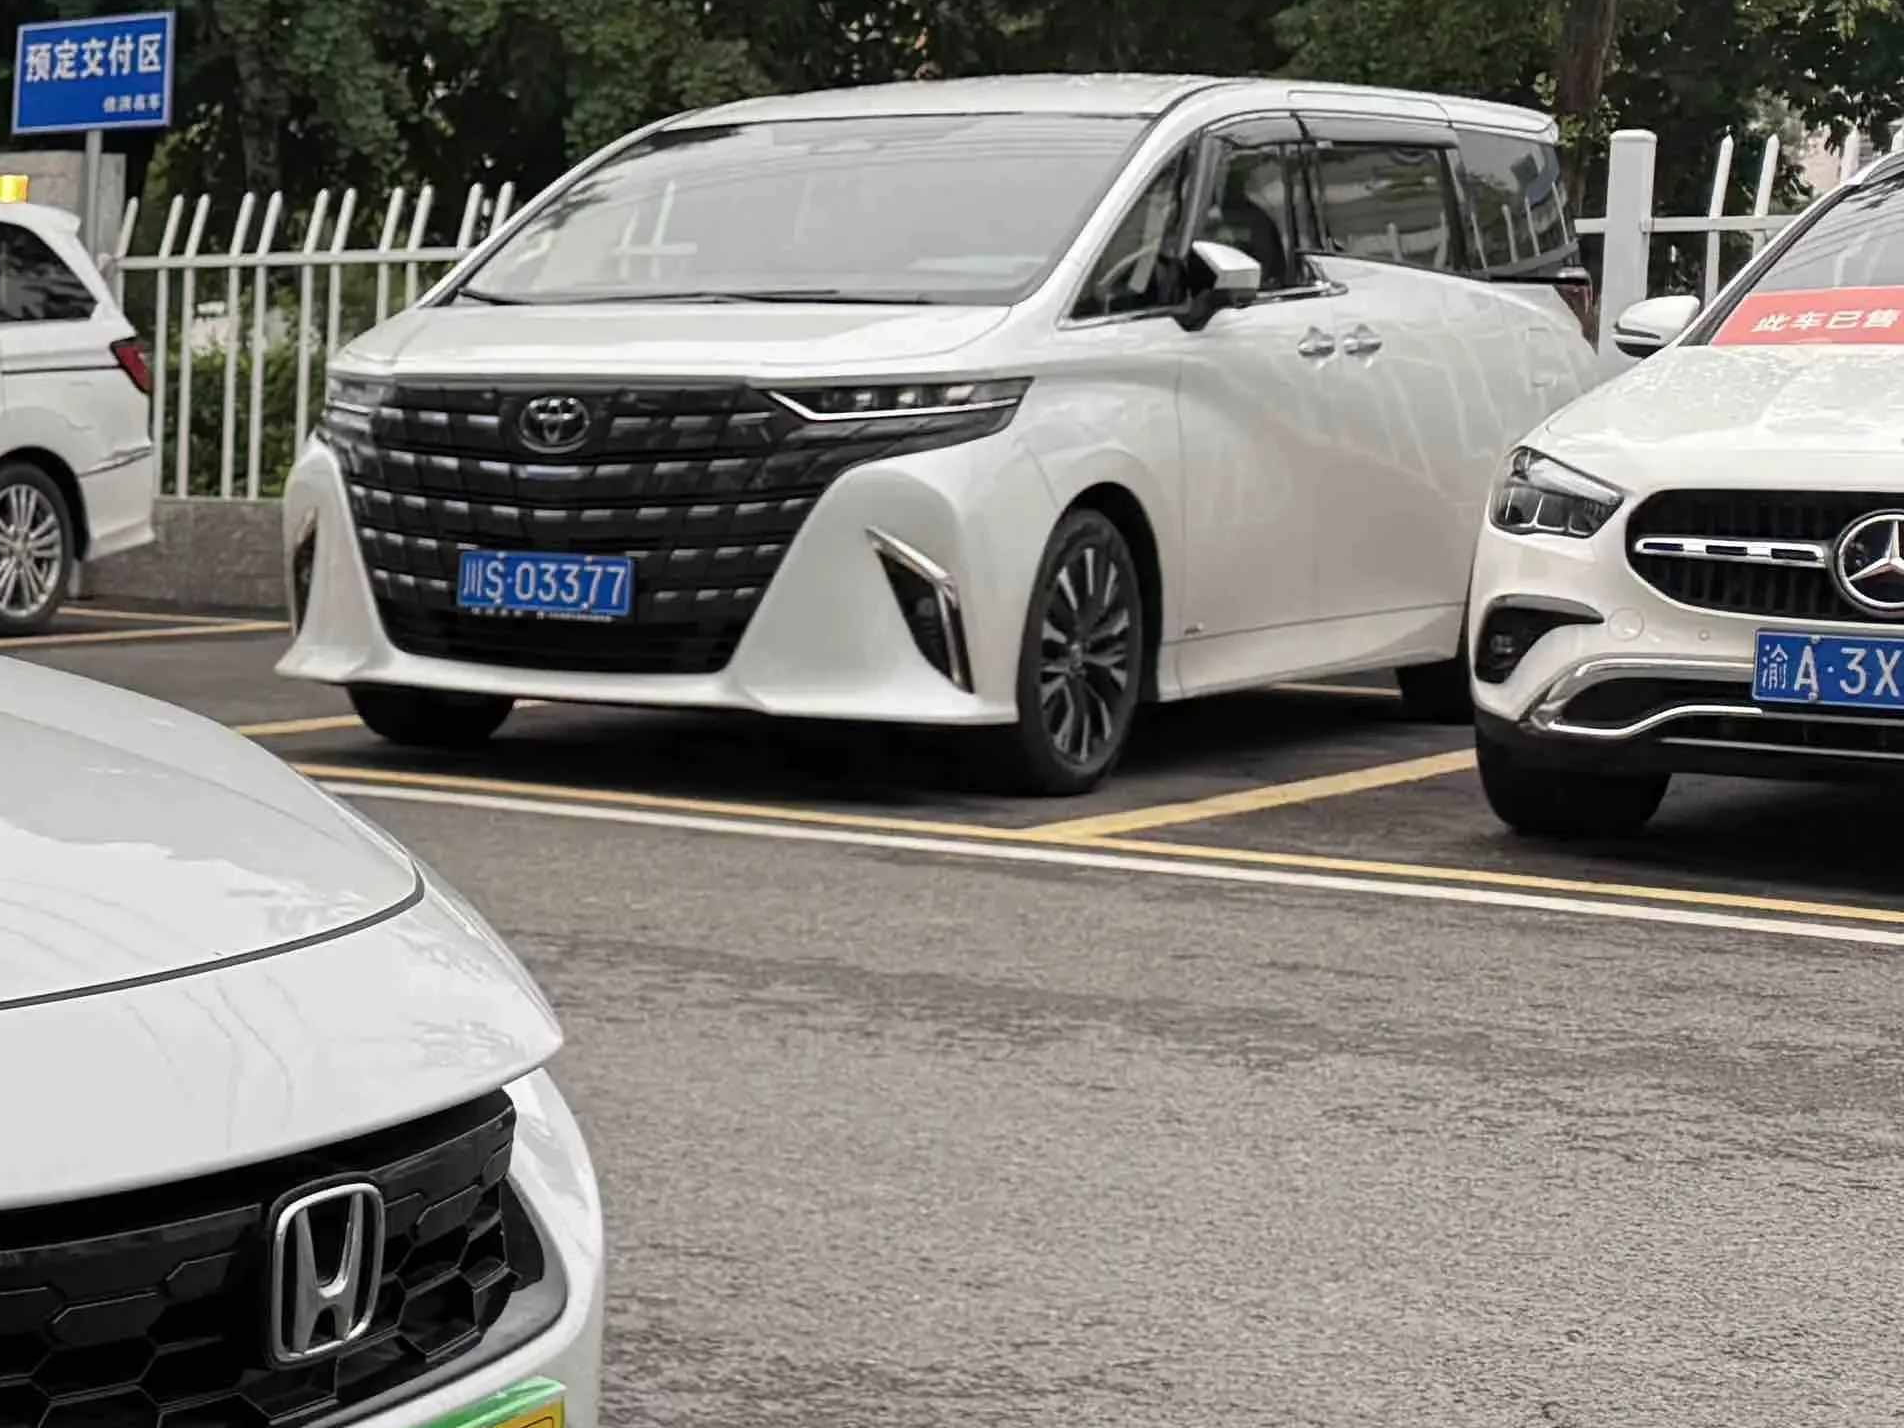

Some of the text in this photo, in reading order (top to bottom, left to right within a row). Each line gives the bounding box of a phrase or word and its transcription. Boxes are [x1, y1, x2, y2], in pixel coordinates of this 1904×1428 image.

[24, 33, 162, 84] 预定交付区
[1750, 308, 1903, 333] 此车已售
